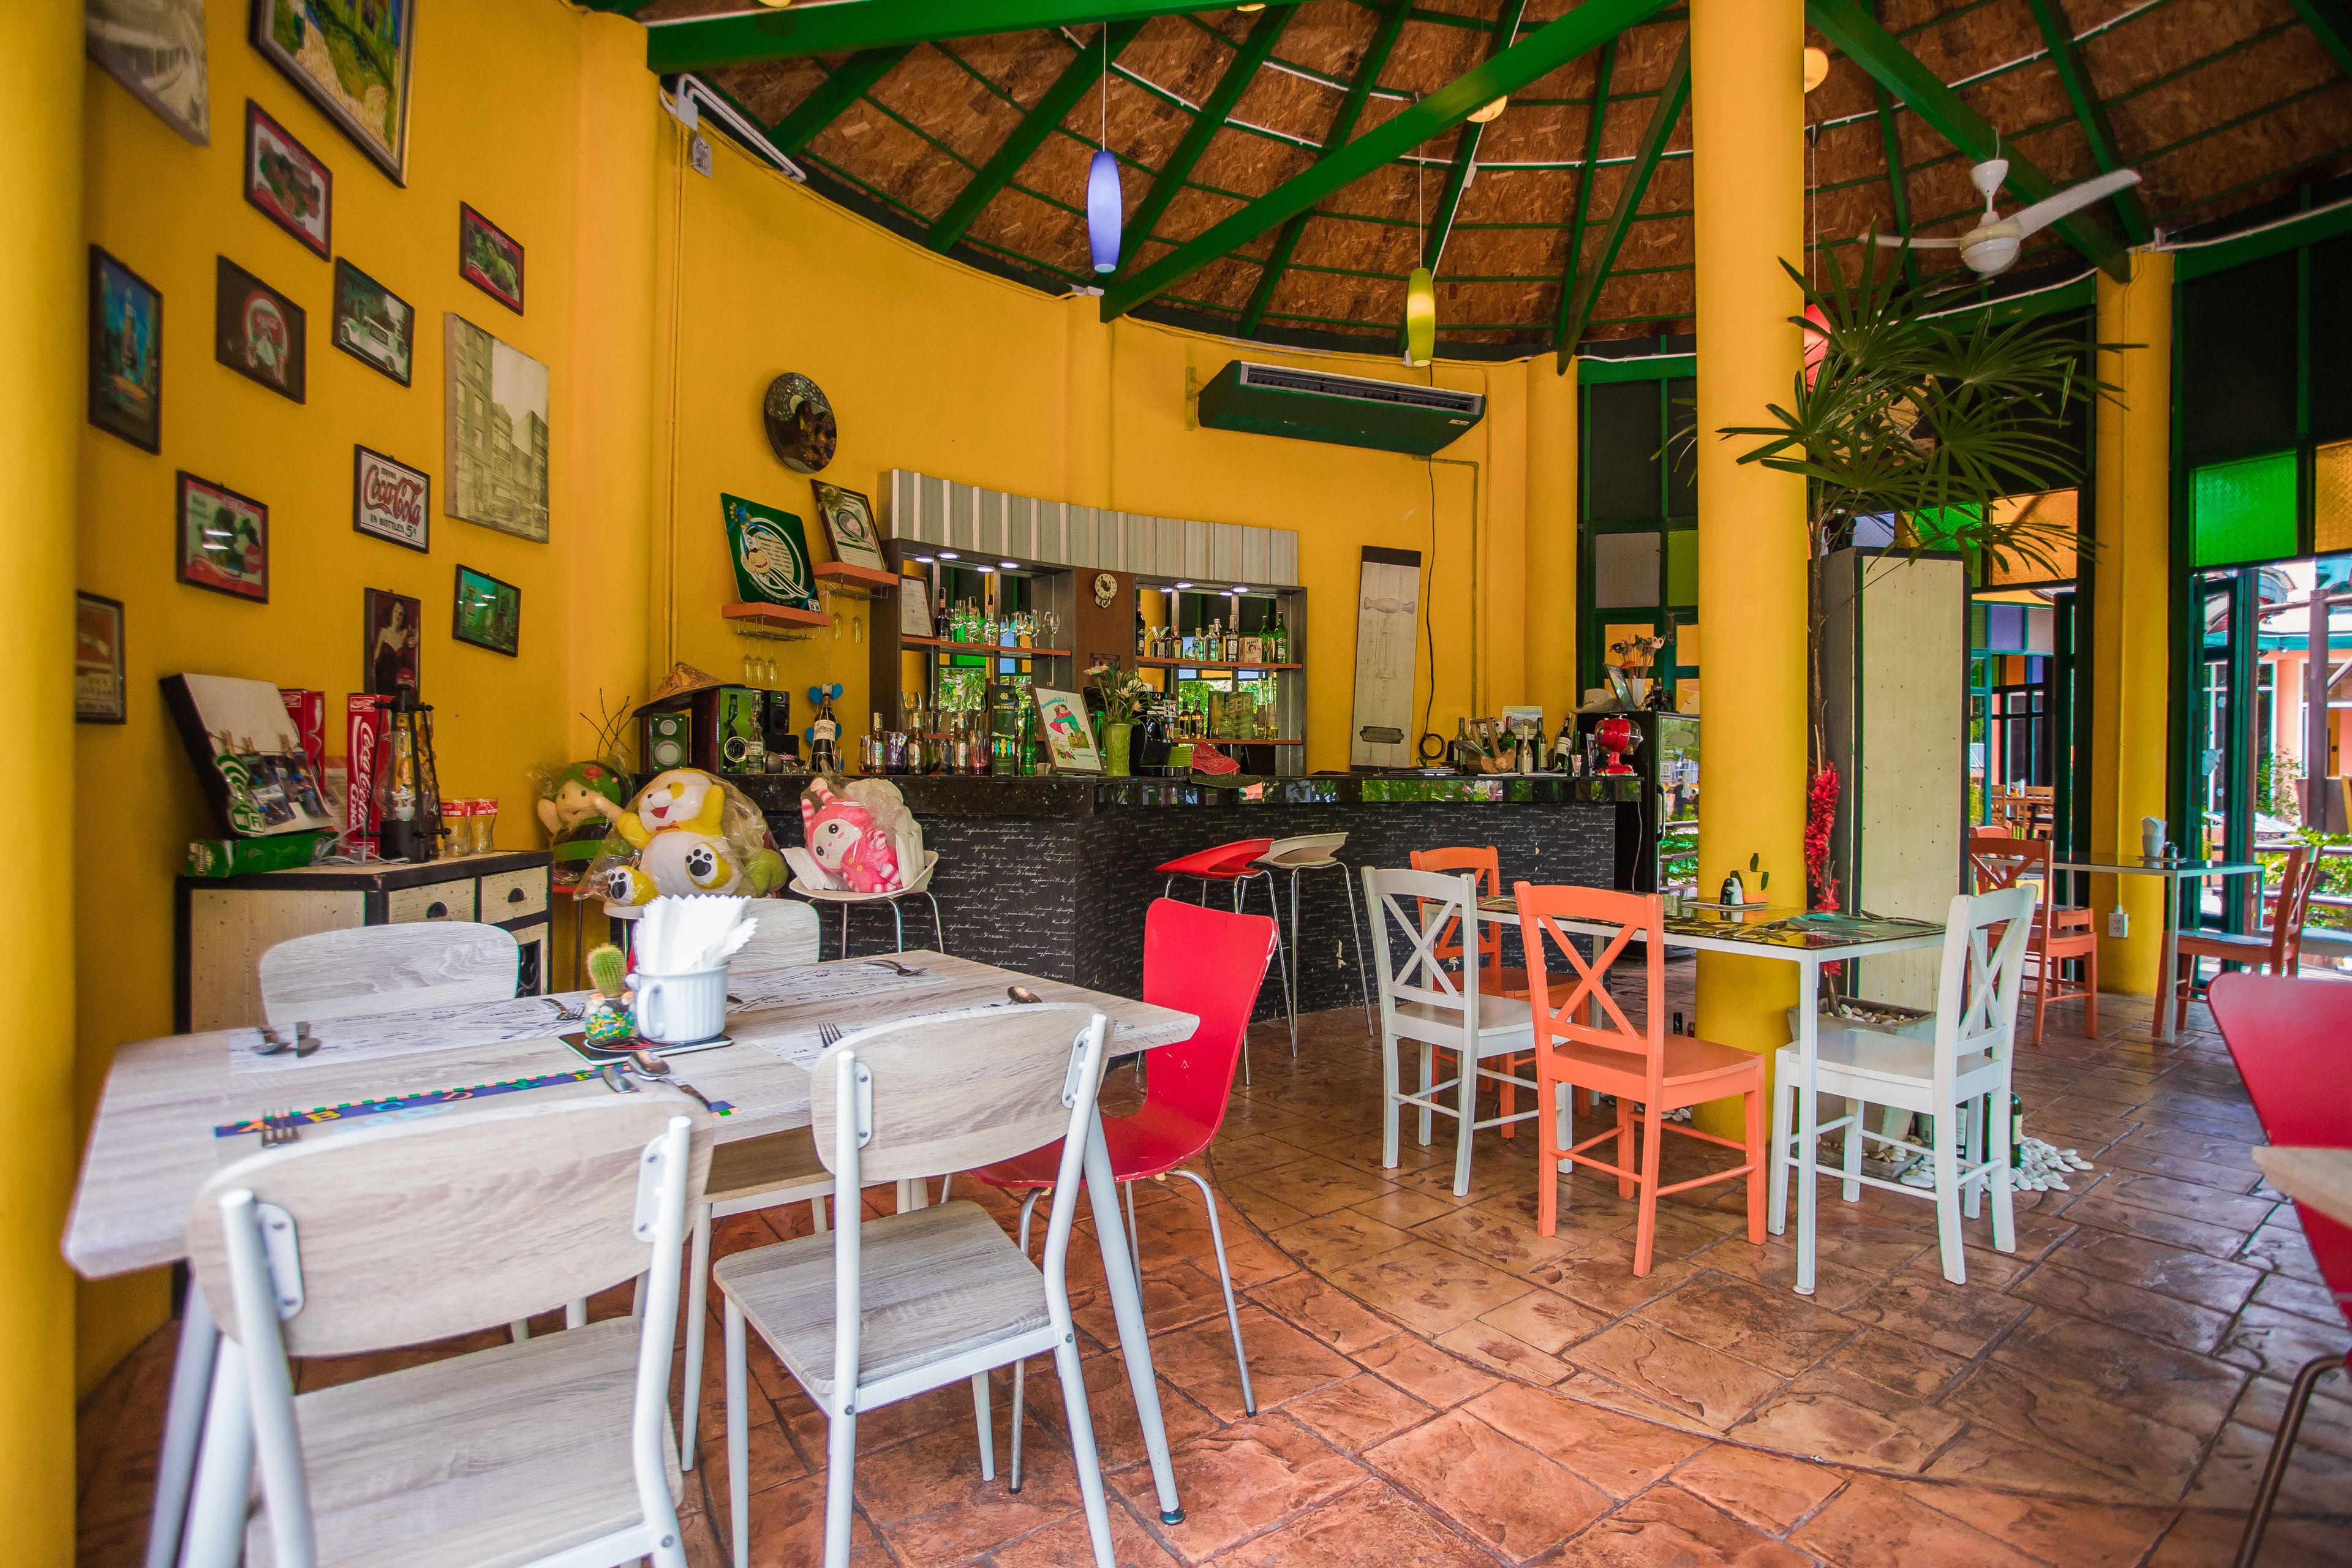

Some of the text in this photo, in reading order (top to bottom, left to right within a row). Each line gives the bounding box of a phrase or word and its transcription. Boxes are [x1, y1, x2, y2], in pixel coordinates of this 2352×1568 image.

[380, 518, 405, 533] BOTTLES
[350, 783, 359, 829] Coke
[306, 1110, 341, 1123] B
[373, 1101, 404, 1112] C
[442, 1091, 473, 1101] D
[509, 1080, 540, 1090] E
[573, 1071, 595, 1082] F
